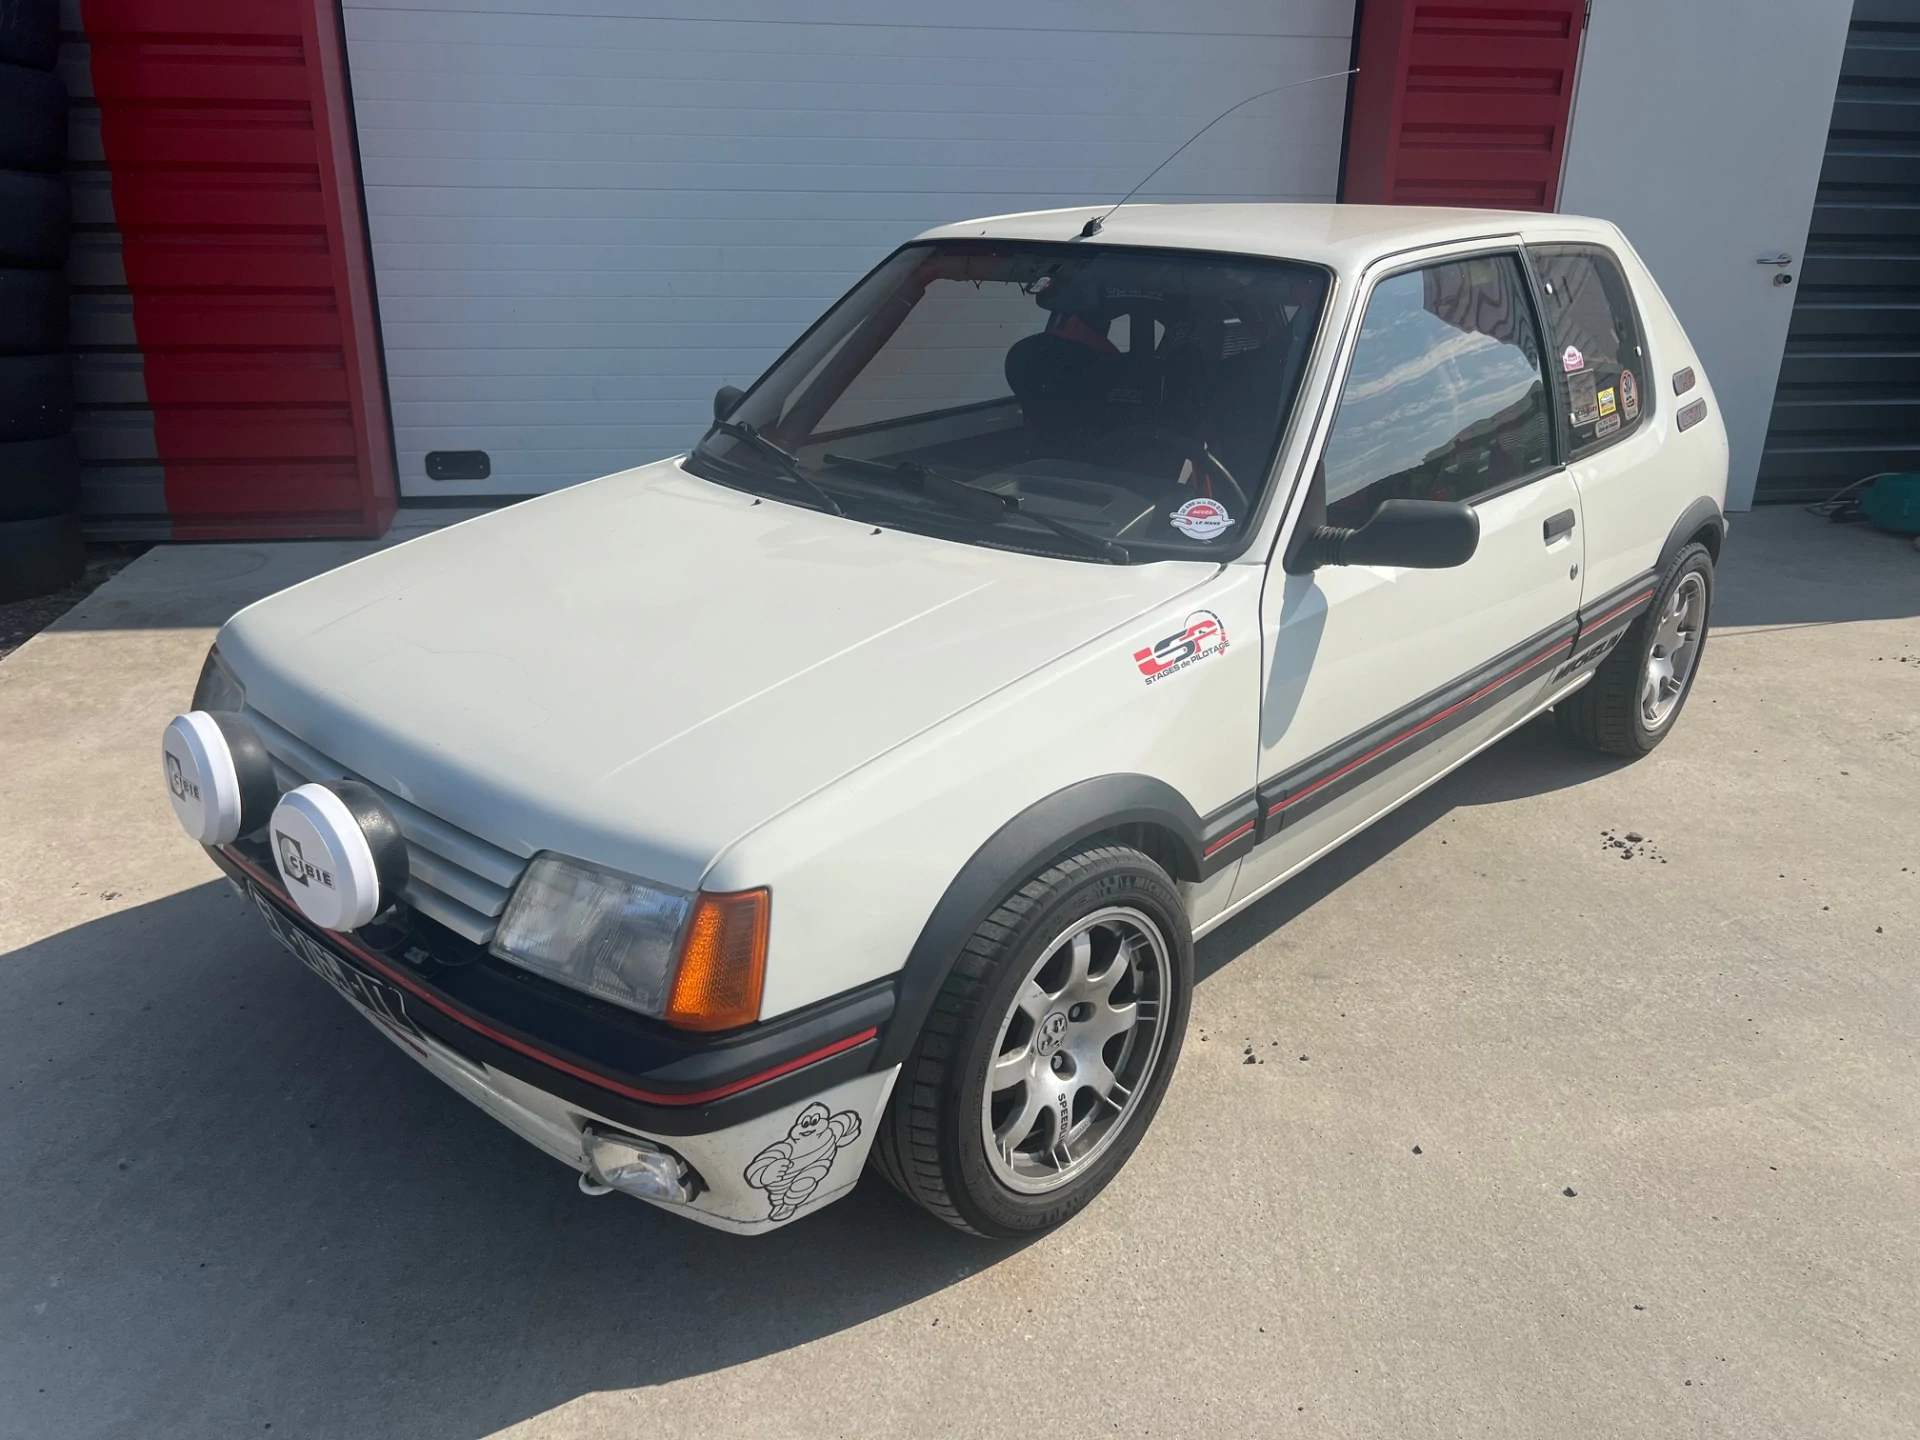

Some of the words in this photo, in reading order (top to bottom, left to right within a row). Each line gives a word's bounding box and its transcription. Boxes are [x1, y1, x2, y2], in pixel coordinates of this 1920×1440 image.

[1145, 663, 1181, 685] STAGES
[1181, 660, 1191, 669] de
[1191, 639, 1230, 664] PILOTAGE
[173, 772, 202, 800] CIBIE
[289, 855, 333, 887] CIBIE
